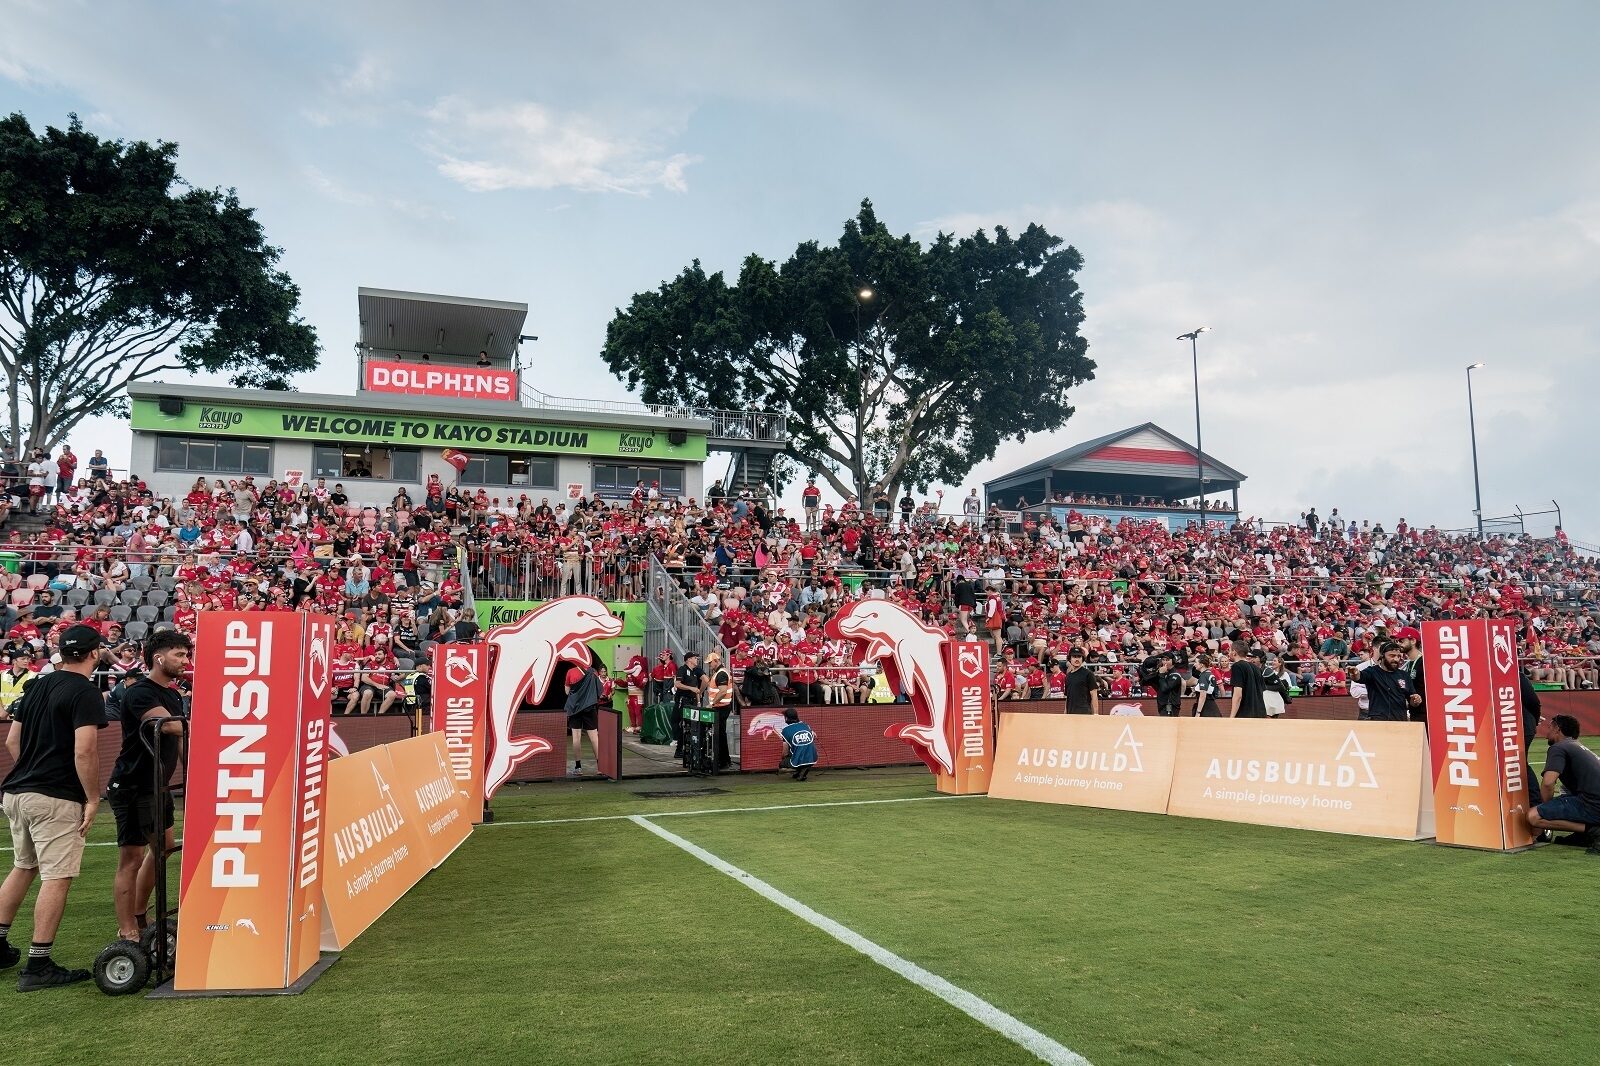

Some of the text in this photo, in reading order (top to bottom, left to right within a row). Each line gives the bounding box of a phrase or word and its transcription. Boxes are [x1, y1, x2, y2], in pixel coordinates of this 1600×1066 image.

[373, 367, 510, 394] DOLPHINS
[199, 422, 224, 430] SPORTS
[200, 407, 243, 429] Kayo
[282, 414, 588, 448] WELCOME TO KAYO STADIUM
[619, 433, 654, 453] Kayo
[962, 686, 984, 757] DOLPHINS
[446, 697, 474, 781] DOLPHINS
[795, 732, 811, 743] FOX
[1498, 686, 1523, 793] DOLPHINS
[1017, 747, 1128, 773] AUSBUILD
[1205, 758, 1356, 788] AUSBUILD
[415, 776, 452, 814] AUSBUILD
[1014, 771, 1123, 791] A simple journey home
[300, 718, 324, 889] DOLPHINS
[1203, 786, 1353, 810] A simple journey home
[333, 803, 399, 867] AUSBUILD
[346, 844, 409, 899] A simple journey home
